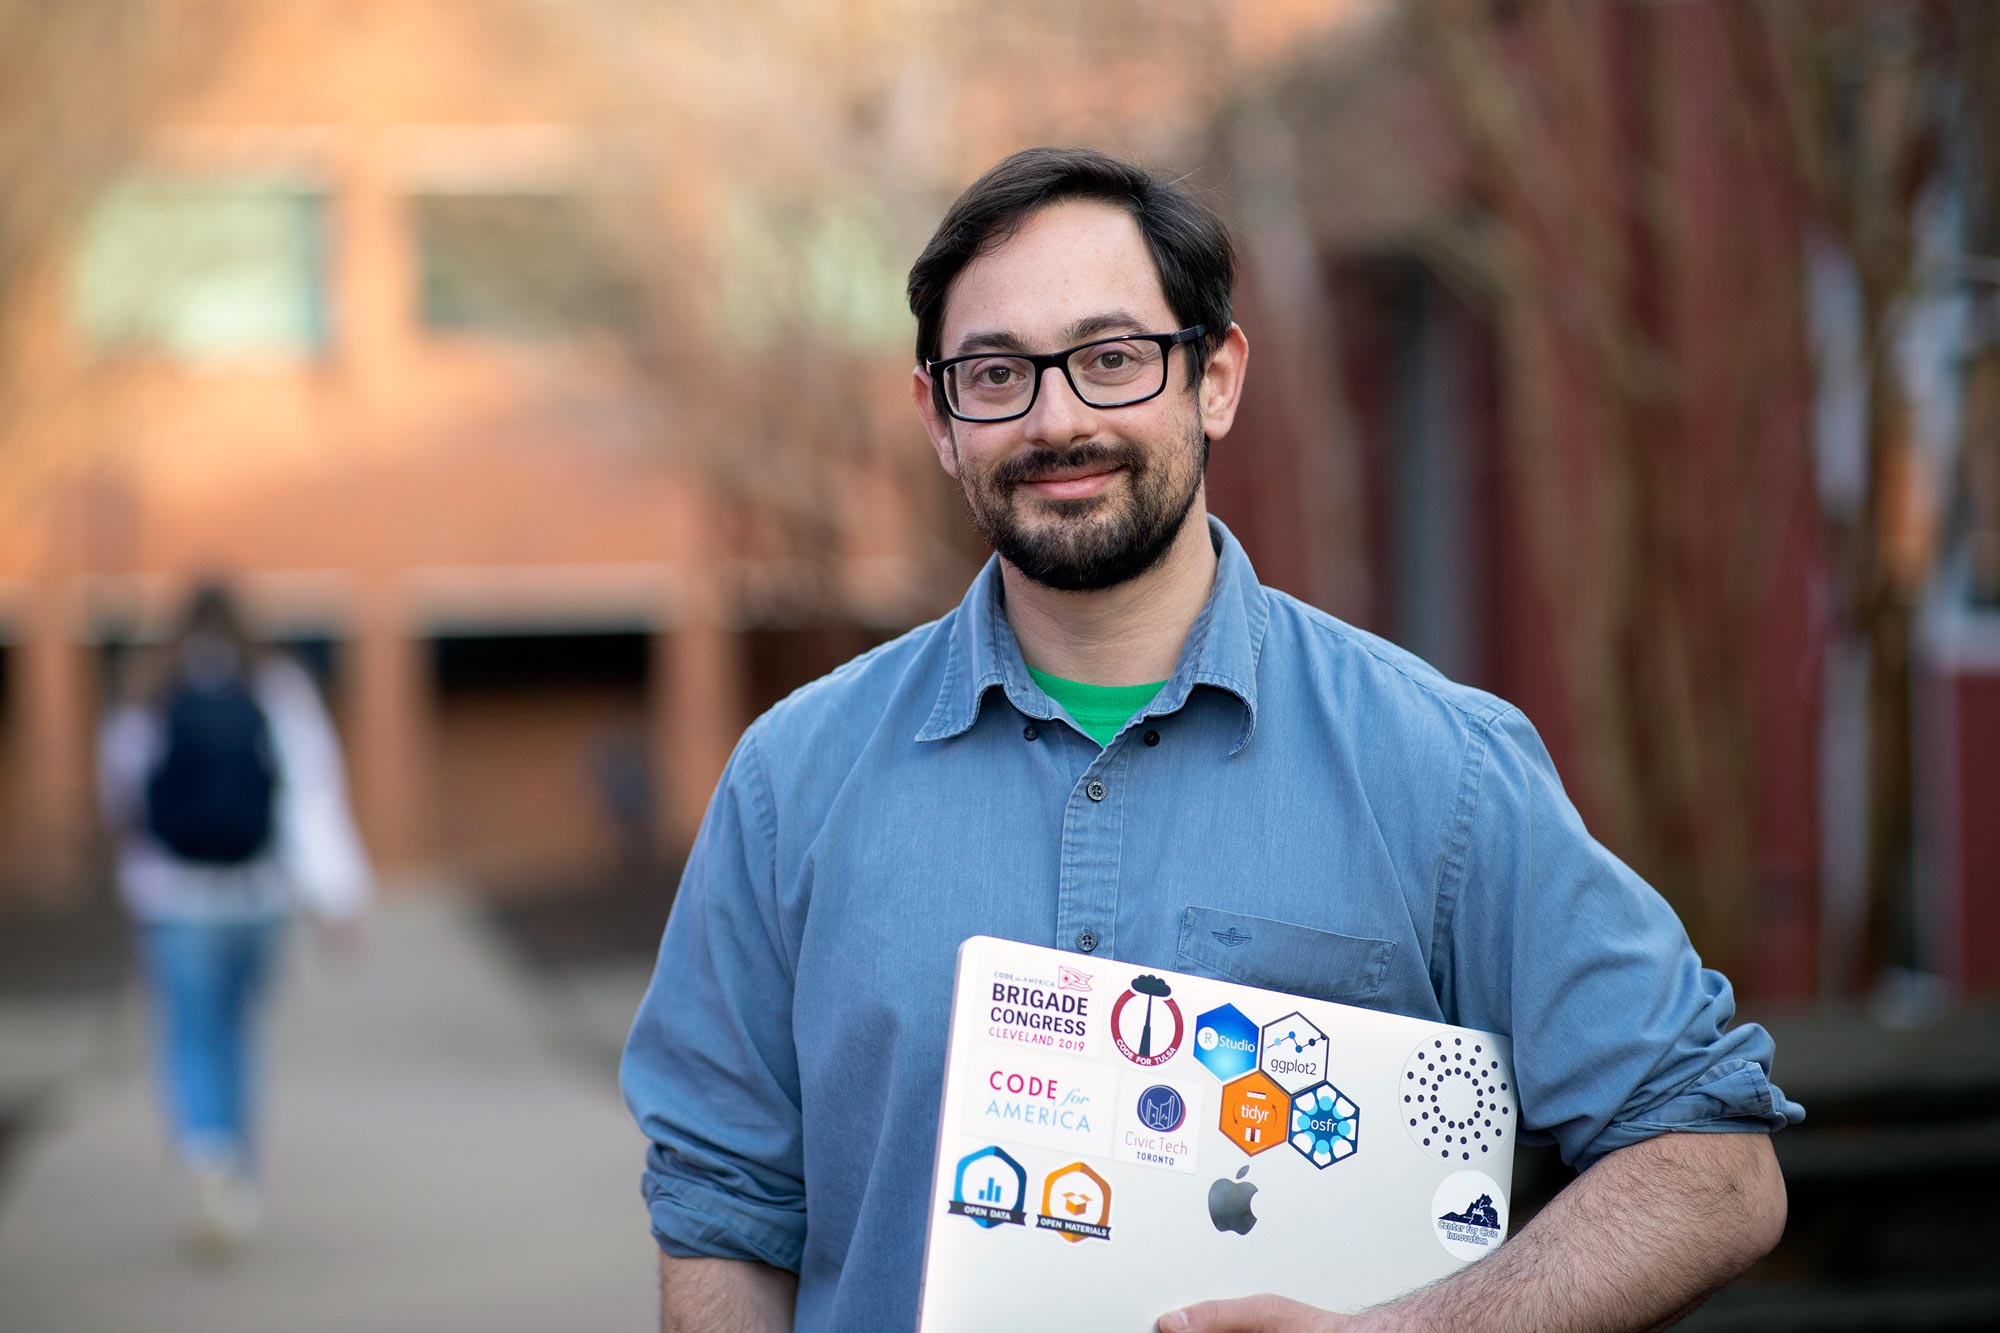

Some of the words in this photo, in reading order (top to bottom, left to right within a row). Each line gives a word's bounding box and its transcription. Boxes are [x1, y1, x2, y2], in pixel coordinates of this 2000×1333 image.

[992, 982, 1089, 1017] BRIGADE
[990, 1006, 1087, 1037] CONGRESS
[988, 1026, 1054, 1046] CLEVELAND
[1058, 1038, 1086, 1052] 2019
[1116, 1038, 1135, 1060] CODE
[1135, 1056, 1152, 1066] FOR
[1154, 1046, 1177, 1065] TULSA
[1270, 1058, 1318, 1076] ggplot2
[989, 1070, 1058, 1100] CODE
[1060, 1087, 1091, 1107] for
[985, 1099, 1091, 1133] AMERICA
[1240, 1104, 1270, 1124] tidyr
[1310, 1118, 1338, 1134] osfr
[1125, 1130, 1156, 1150] Civic
[1159, 1136, 1188, 1156] Tech
[1136, 1151, 1175, 1166] TORONTO
[963, 1204, 988, 1218] OPEN
[989, 1207, 1012, 1221] DATA
[1040, 1217, 1063, 1229] OPEN
[1064, 1219, 1108, 1237] MATERIALS
[1438, 1220, 1465, 1232] Center
[1466, 1224, 1479, 1235] for
[1480, 1227, 1498, 1238] Civic
[1447, 1231, 1488, 1246] Innovation
